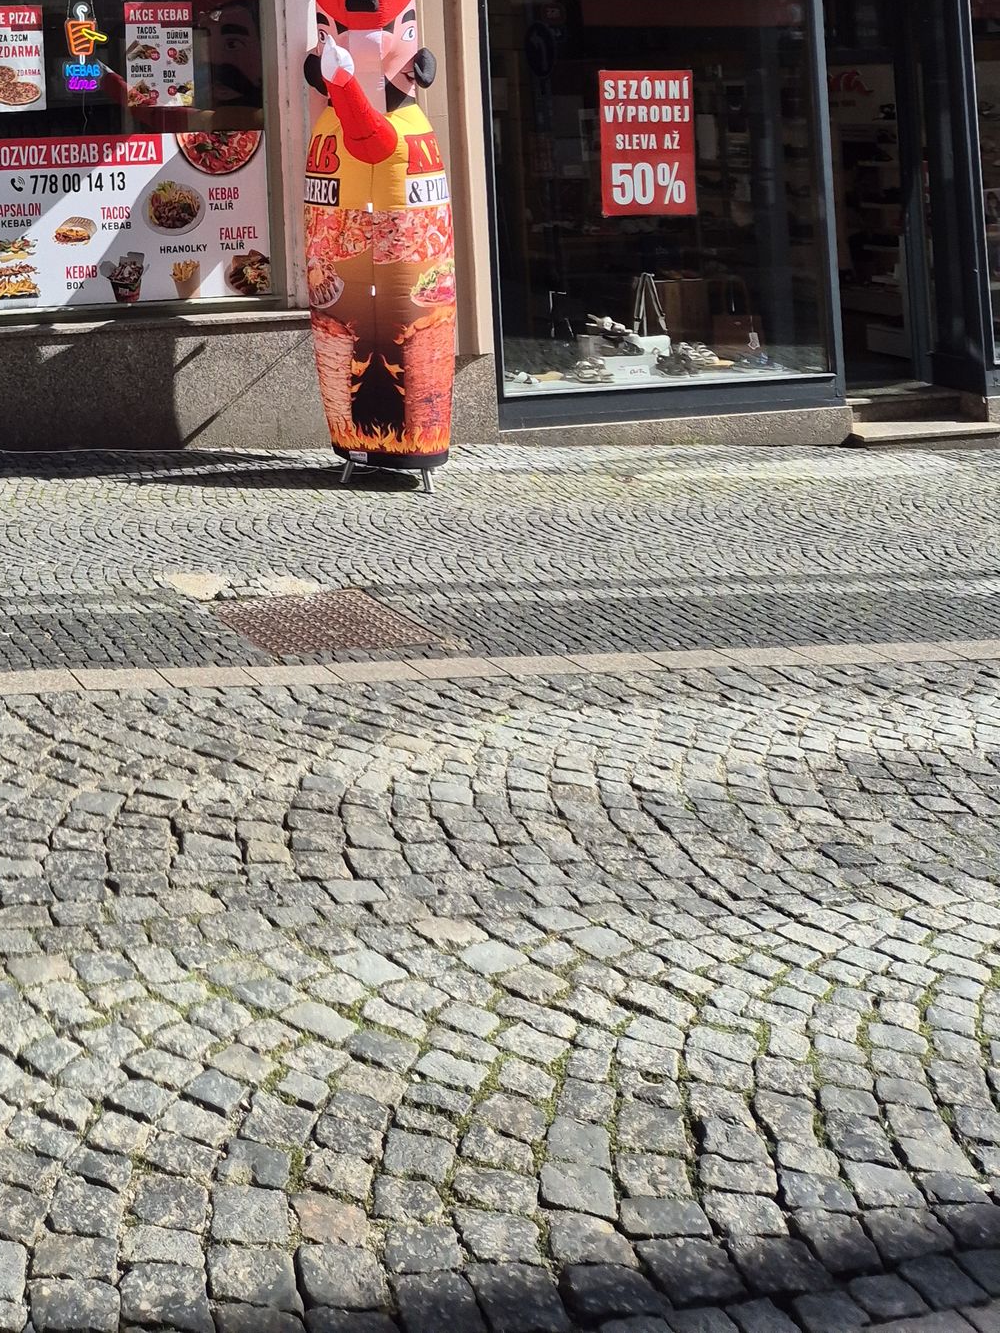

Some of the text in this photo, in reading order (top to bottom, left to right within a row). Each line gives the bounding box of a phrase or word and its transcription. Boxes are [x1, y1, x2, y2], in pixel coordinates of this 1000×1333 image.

[9, 11, 37, 24] PIZZA
[129, 8, 189, 21] AKCE KEBAB
[136, 26, 157, 34] TACOS
[10, 33, 29, 42] 32CM
[17, 68, 41, 77] ZDARMA
[65, 64, 101, 77] KEBAB
[163, 70, 176, 78] BOX
[68, 76, 98, 90] time
[603, 77, 689, 100] SEZÓNNÍ
[604, 103, 690, 123] VÝPRODEJ
[615, 131, 680, 150] SLEVA AŽ
[51, 143, 99, 165] KEBAB
[103, 143, 112, 163] &
[116, 141, 156, 162] PIZZA
[30, 171, 126, 194] 778 00 14 13
[611, 162, 686, 205] 50%
[208, 186, 239, 200] KEBAB
[409, 180, 423, 204] &
[209, 200, 234, 211] TALÍŘ
[101, 206, 131, 220] TACOS
[1, 219, 32, 228] KEBAB
[101, 221, 132, 230] KEBAB
[219, 226, 258, 240] FALAFEL
[160, 243, 208, 254] HRANOLKY
[220, 240, 245, 251] TALÍŘ
[65, 265, 98, 279] KEBAB
[66, 281, 85, 290] BOX
